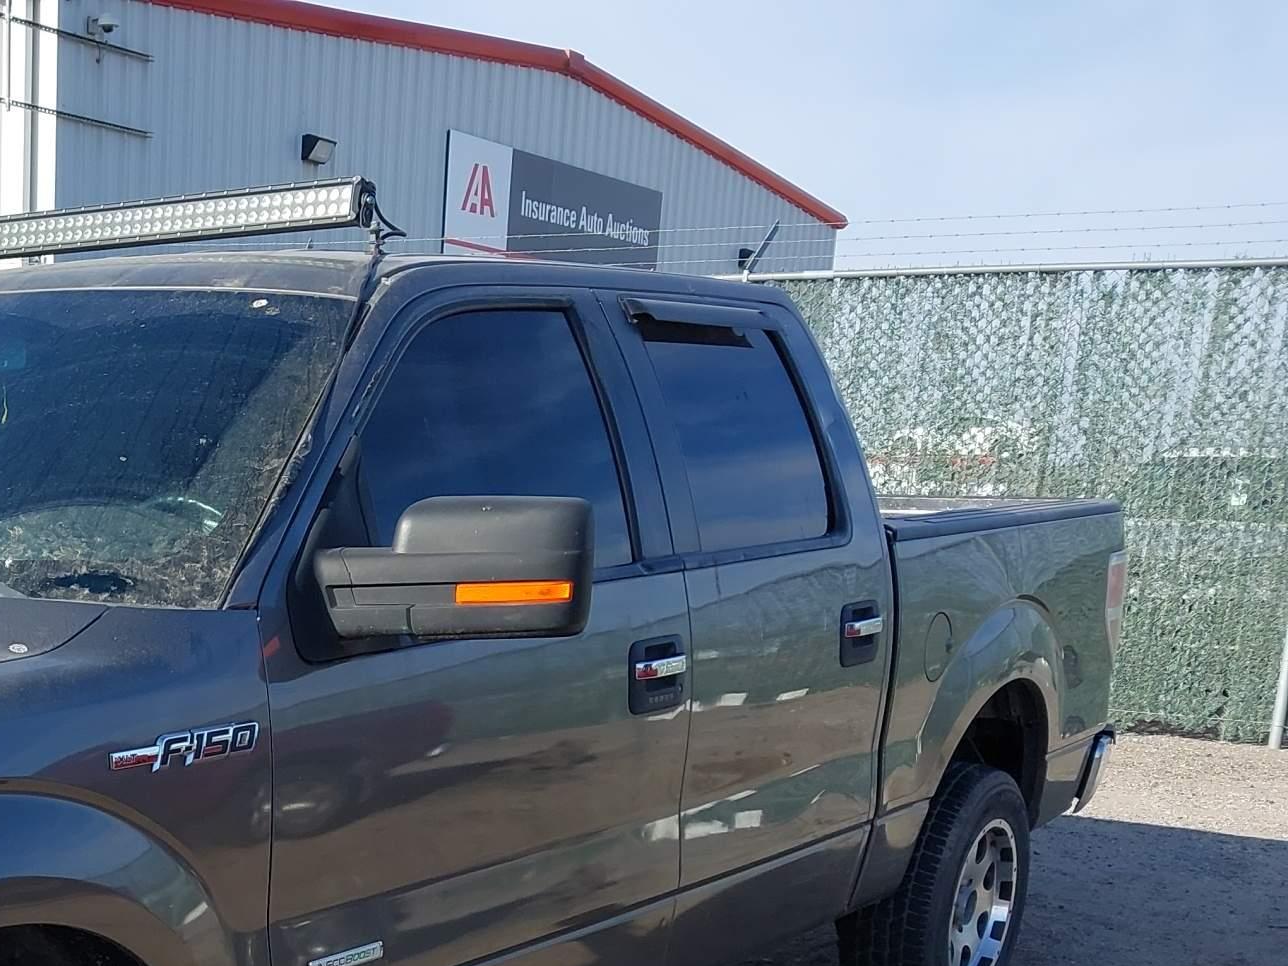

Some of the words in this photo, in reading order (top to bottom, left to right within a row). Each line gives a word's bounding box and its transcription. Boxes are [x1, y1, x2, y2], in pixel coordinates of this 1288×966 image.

[520, 190, 577, 229] Insurance
[578, 205, 604, 236] Auto
[605, 213, 650, 247] Auctions
